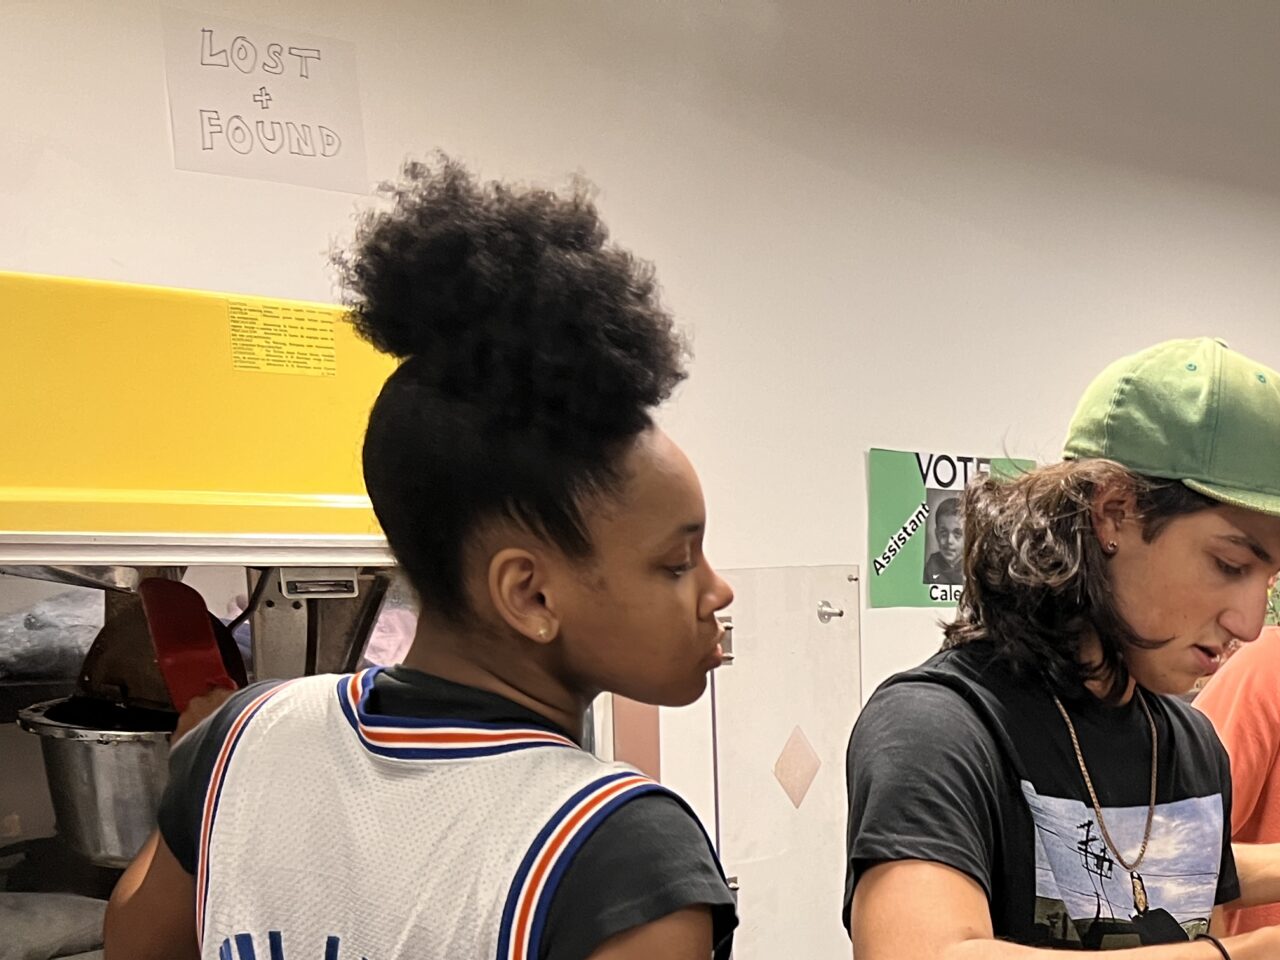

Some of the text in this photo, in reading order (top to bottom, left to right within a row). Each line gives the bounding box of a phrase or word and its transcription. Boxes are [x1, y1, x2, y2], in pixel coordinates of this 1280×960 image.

[200, 28, 322, 79] LOST
[253, 86, 273, 110] +
[200, 109, 342, 158] FOUND
[914, 452, 991, 488] VOTE
[872, 502, 931, 576] Assistant
[929, 585, 962, 601] Cale
